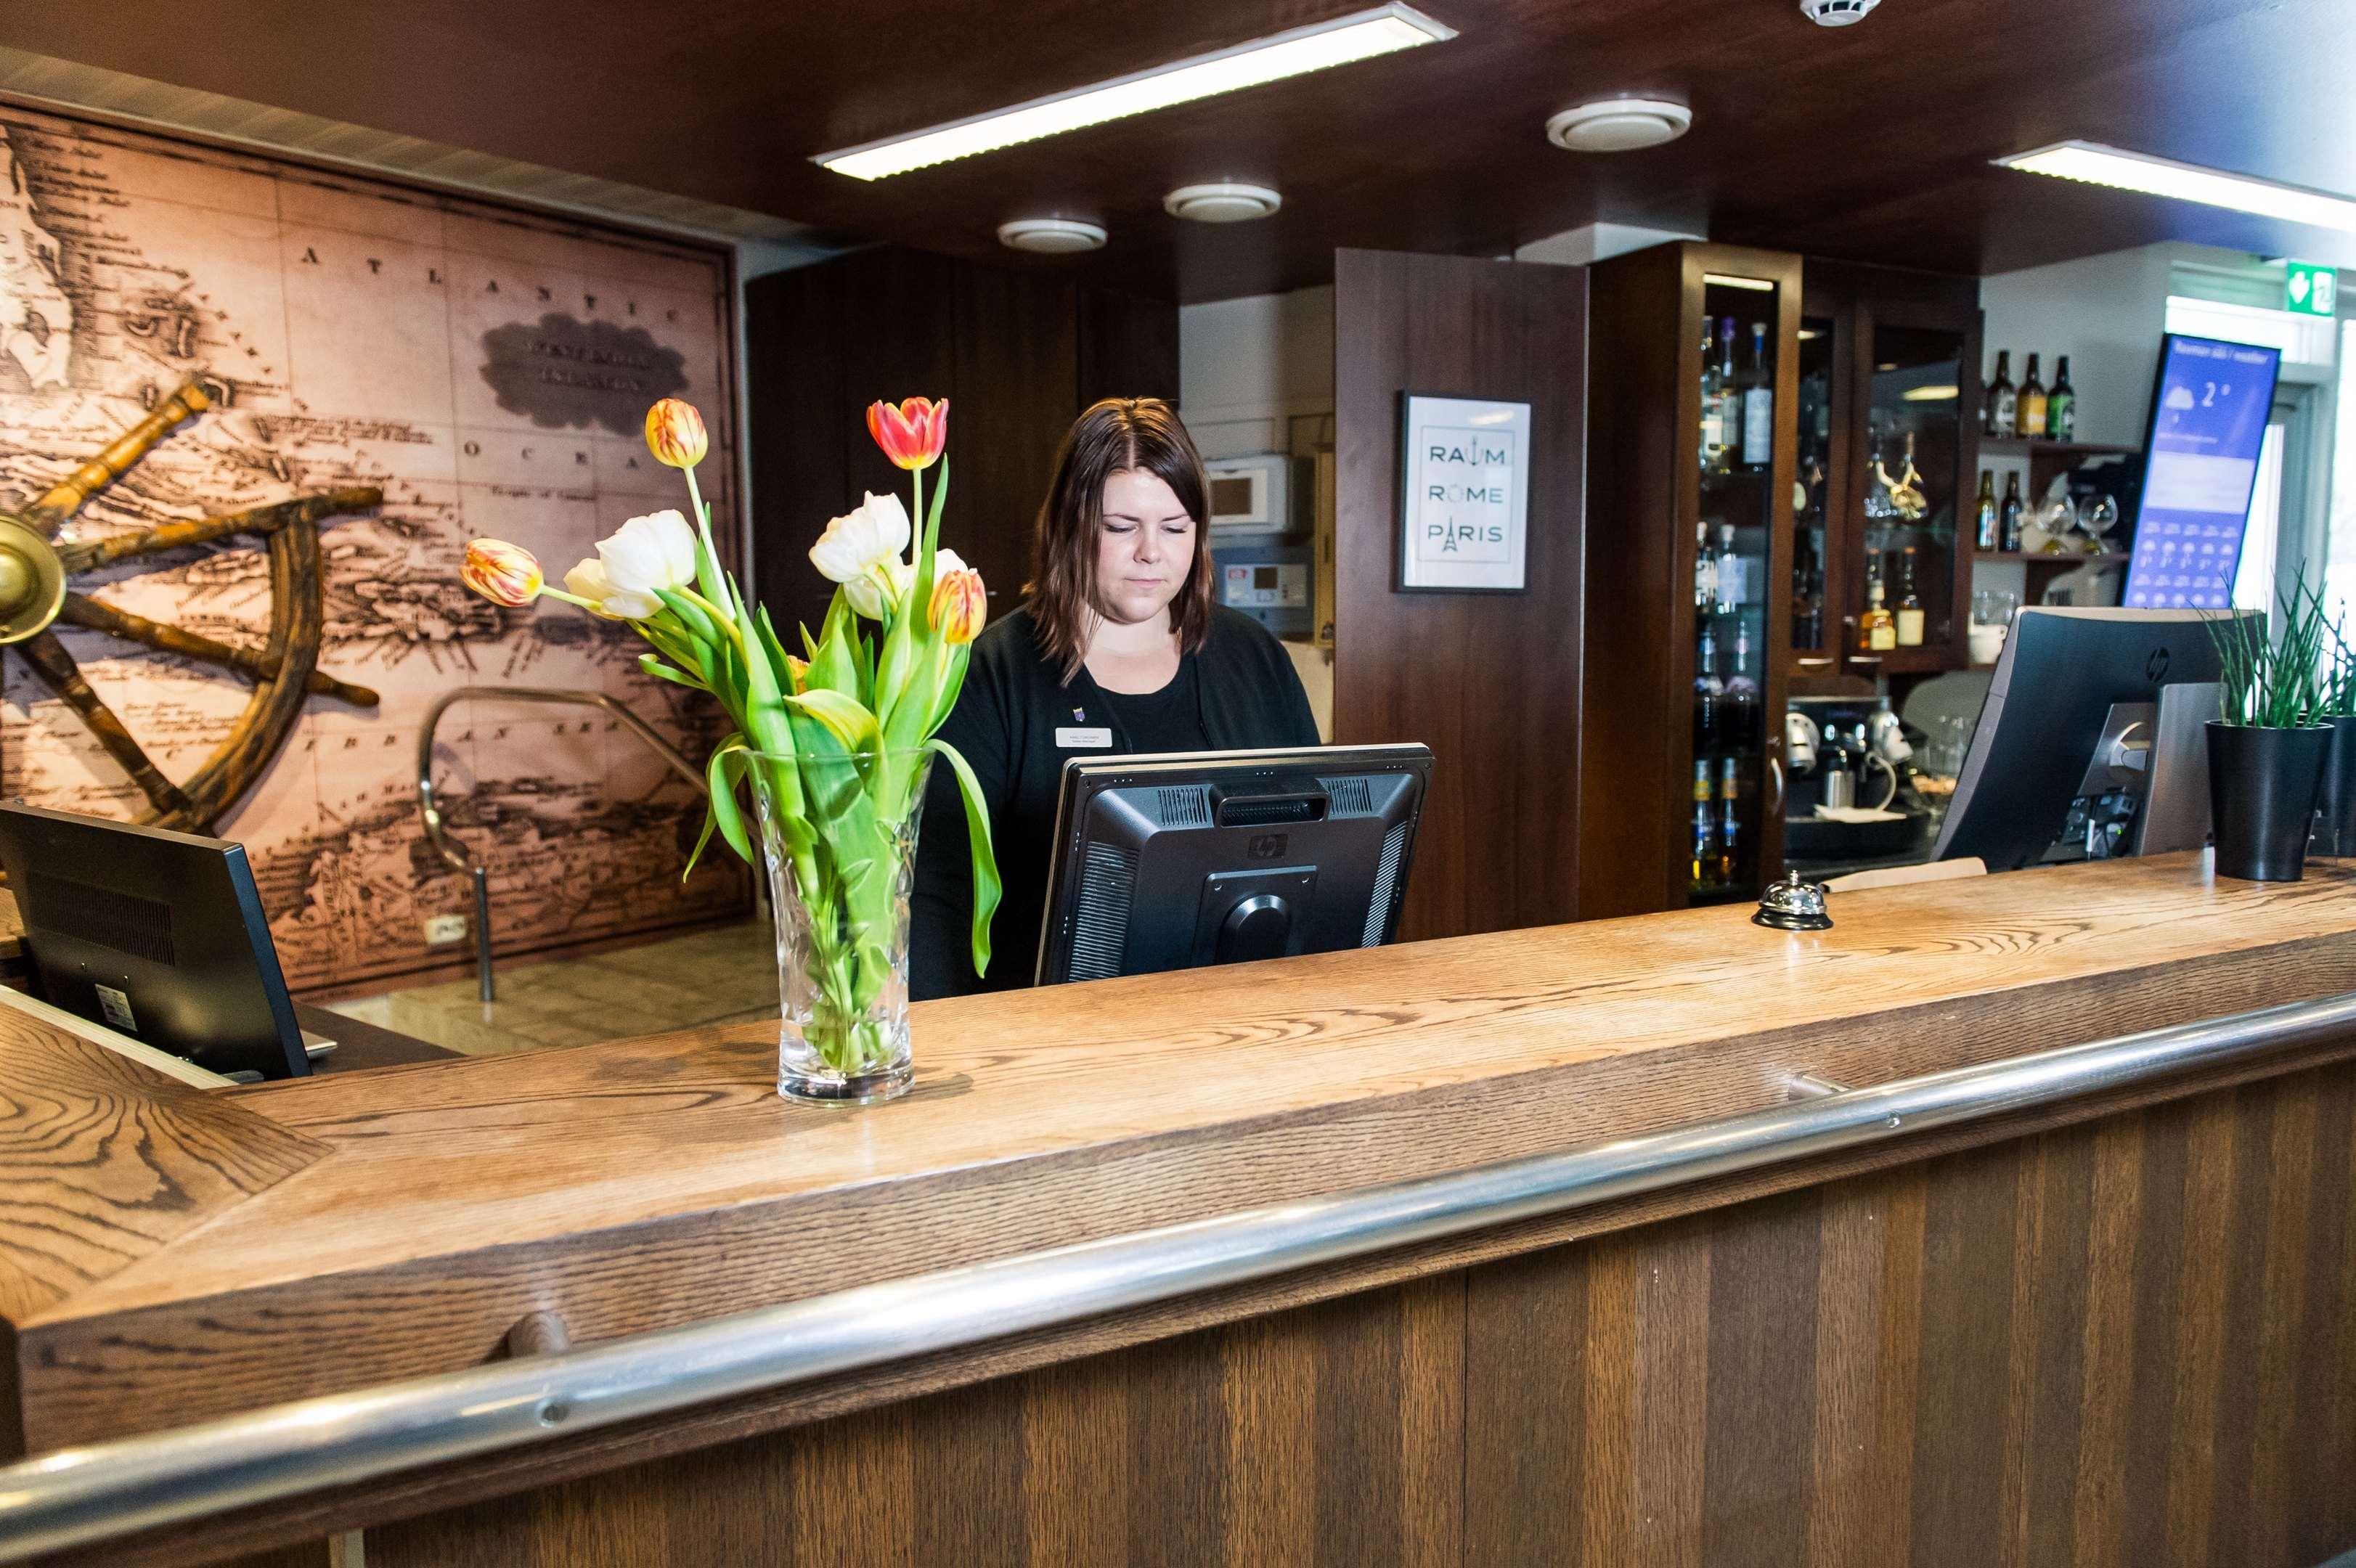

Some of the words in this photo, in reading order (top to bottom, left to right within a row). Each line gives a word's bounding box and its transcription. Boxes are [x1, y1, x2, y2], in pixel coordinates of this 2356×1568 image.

[464, 440, 639, 470] OCEA
[1428, 483, 1503, 504] ROME
[1427, 517, 1503, 552] PARIS
[1257, 836, 1278, 857] hp
